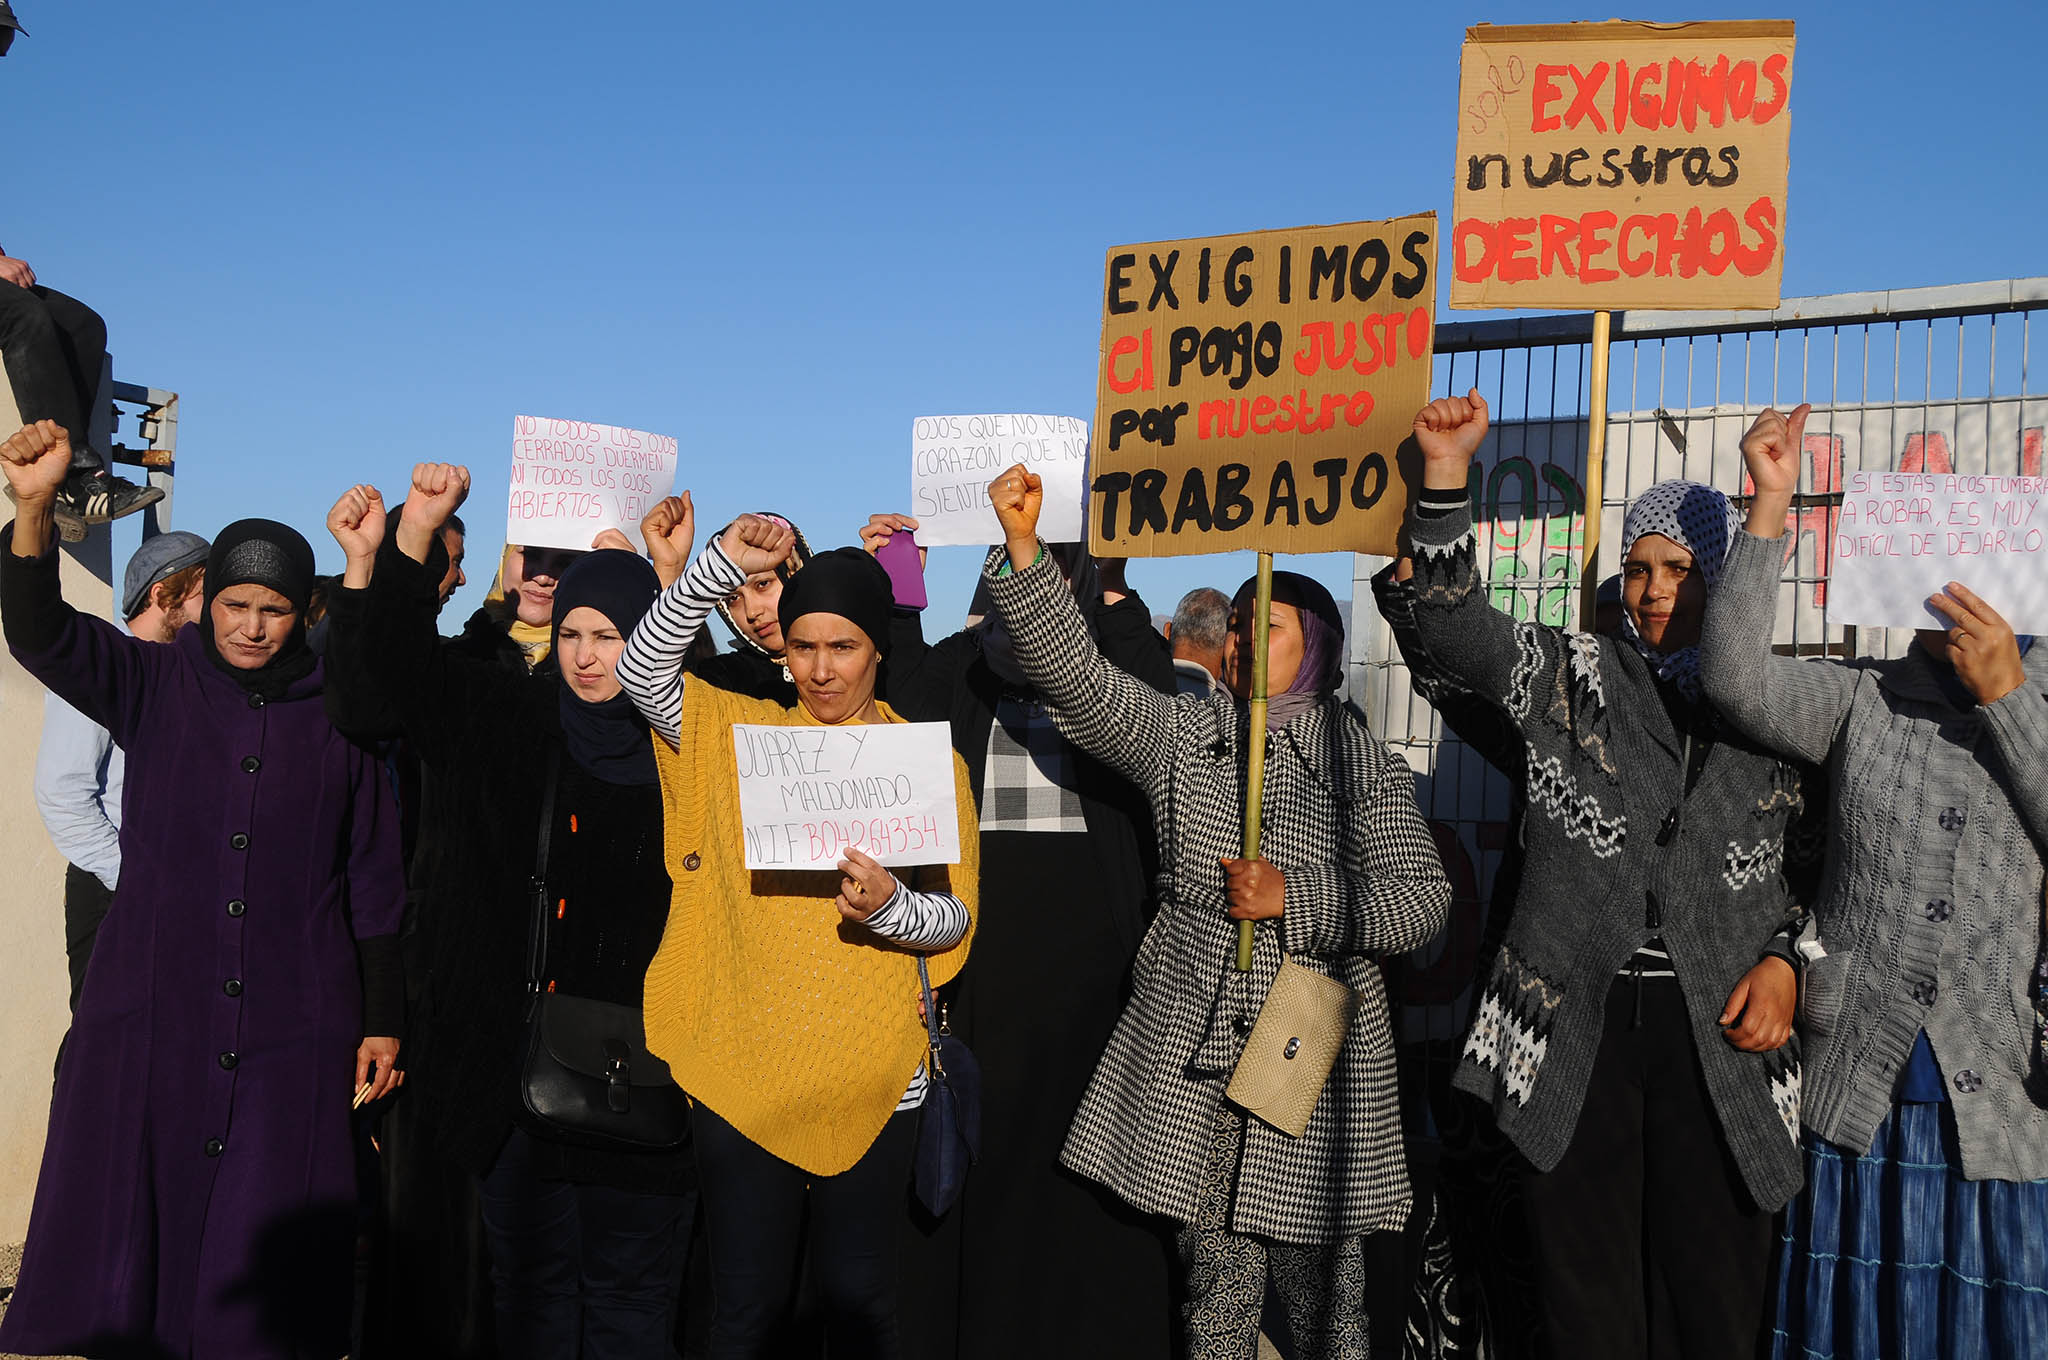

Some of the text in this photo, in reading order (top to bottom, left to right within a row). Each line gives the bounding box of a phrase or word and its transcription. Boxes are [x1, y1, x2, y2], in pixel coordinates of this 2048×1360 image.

[1530, 53, 1788, 135] EXIGIMOS
[1466, 144, 1740, 191] nuestros
[1453, 196, 1778, 284] DERECHOS
[1107, 230, 1430, 315] EXIGIMOS
[1106, 306, 1430, 394] el pago JUSTO
[515, 415, 677, 455] NO TODOS LOS OJOS
[916, 414, 1080, 440] OJOS QUE NO VEN
[1108, 388, 1375, 451] por nuestro
[513, 438, 595, 465] CERRADOS
[1011, 438, 1056, 466] QUE
[1063, 437, 1086, 461] NO
[511, 463, 652, 495] NI TODOS LOS OJOS
[1090, 452, 1389, 542] TRABAJO
[1882, 474, 1936, 493] ESTAS
[509, 490, 646, 522] ABIERTOS VEN
[1841, 501, 1857, 525] A
[1947, 501, 1980, 526] ES
[1991, 499, 2038, 527] MUY
[1909, 533, 1937, 557] DE
[735, 726, 868, 778] JUAREZ Y
